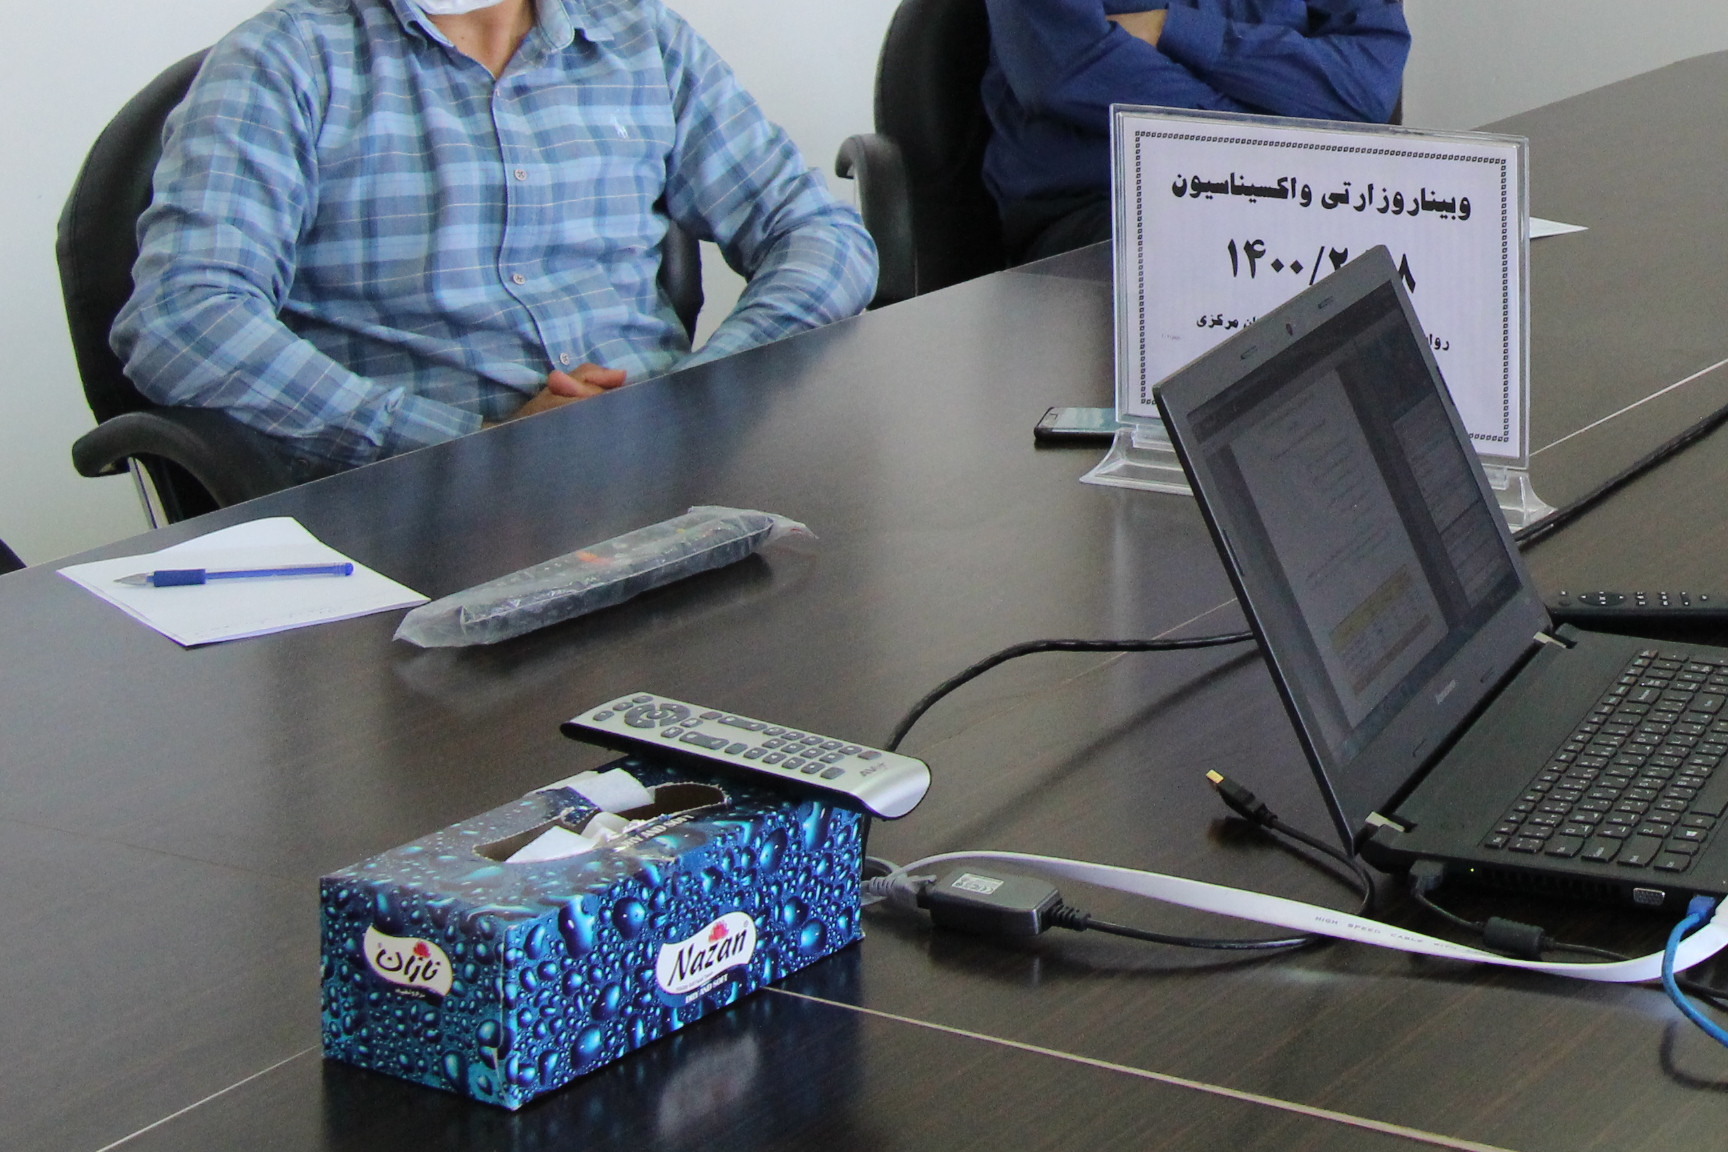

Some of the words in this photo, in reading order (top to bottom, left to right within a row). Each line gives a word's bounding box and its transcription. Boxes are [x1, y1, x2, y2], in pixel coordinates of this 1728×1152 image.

[1171, 171, 1312, 208] واکسیناسیون
[1196, 313, 1239, 330] مرکزی
[375, 948, 442, 983] نازان
[667, 929, 748, 987] Nazan
